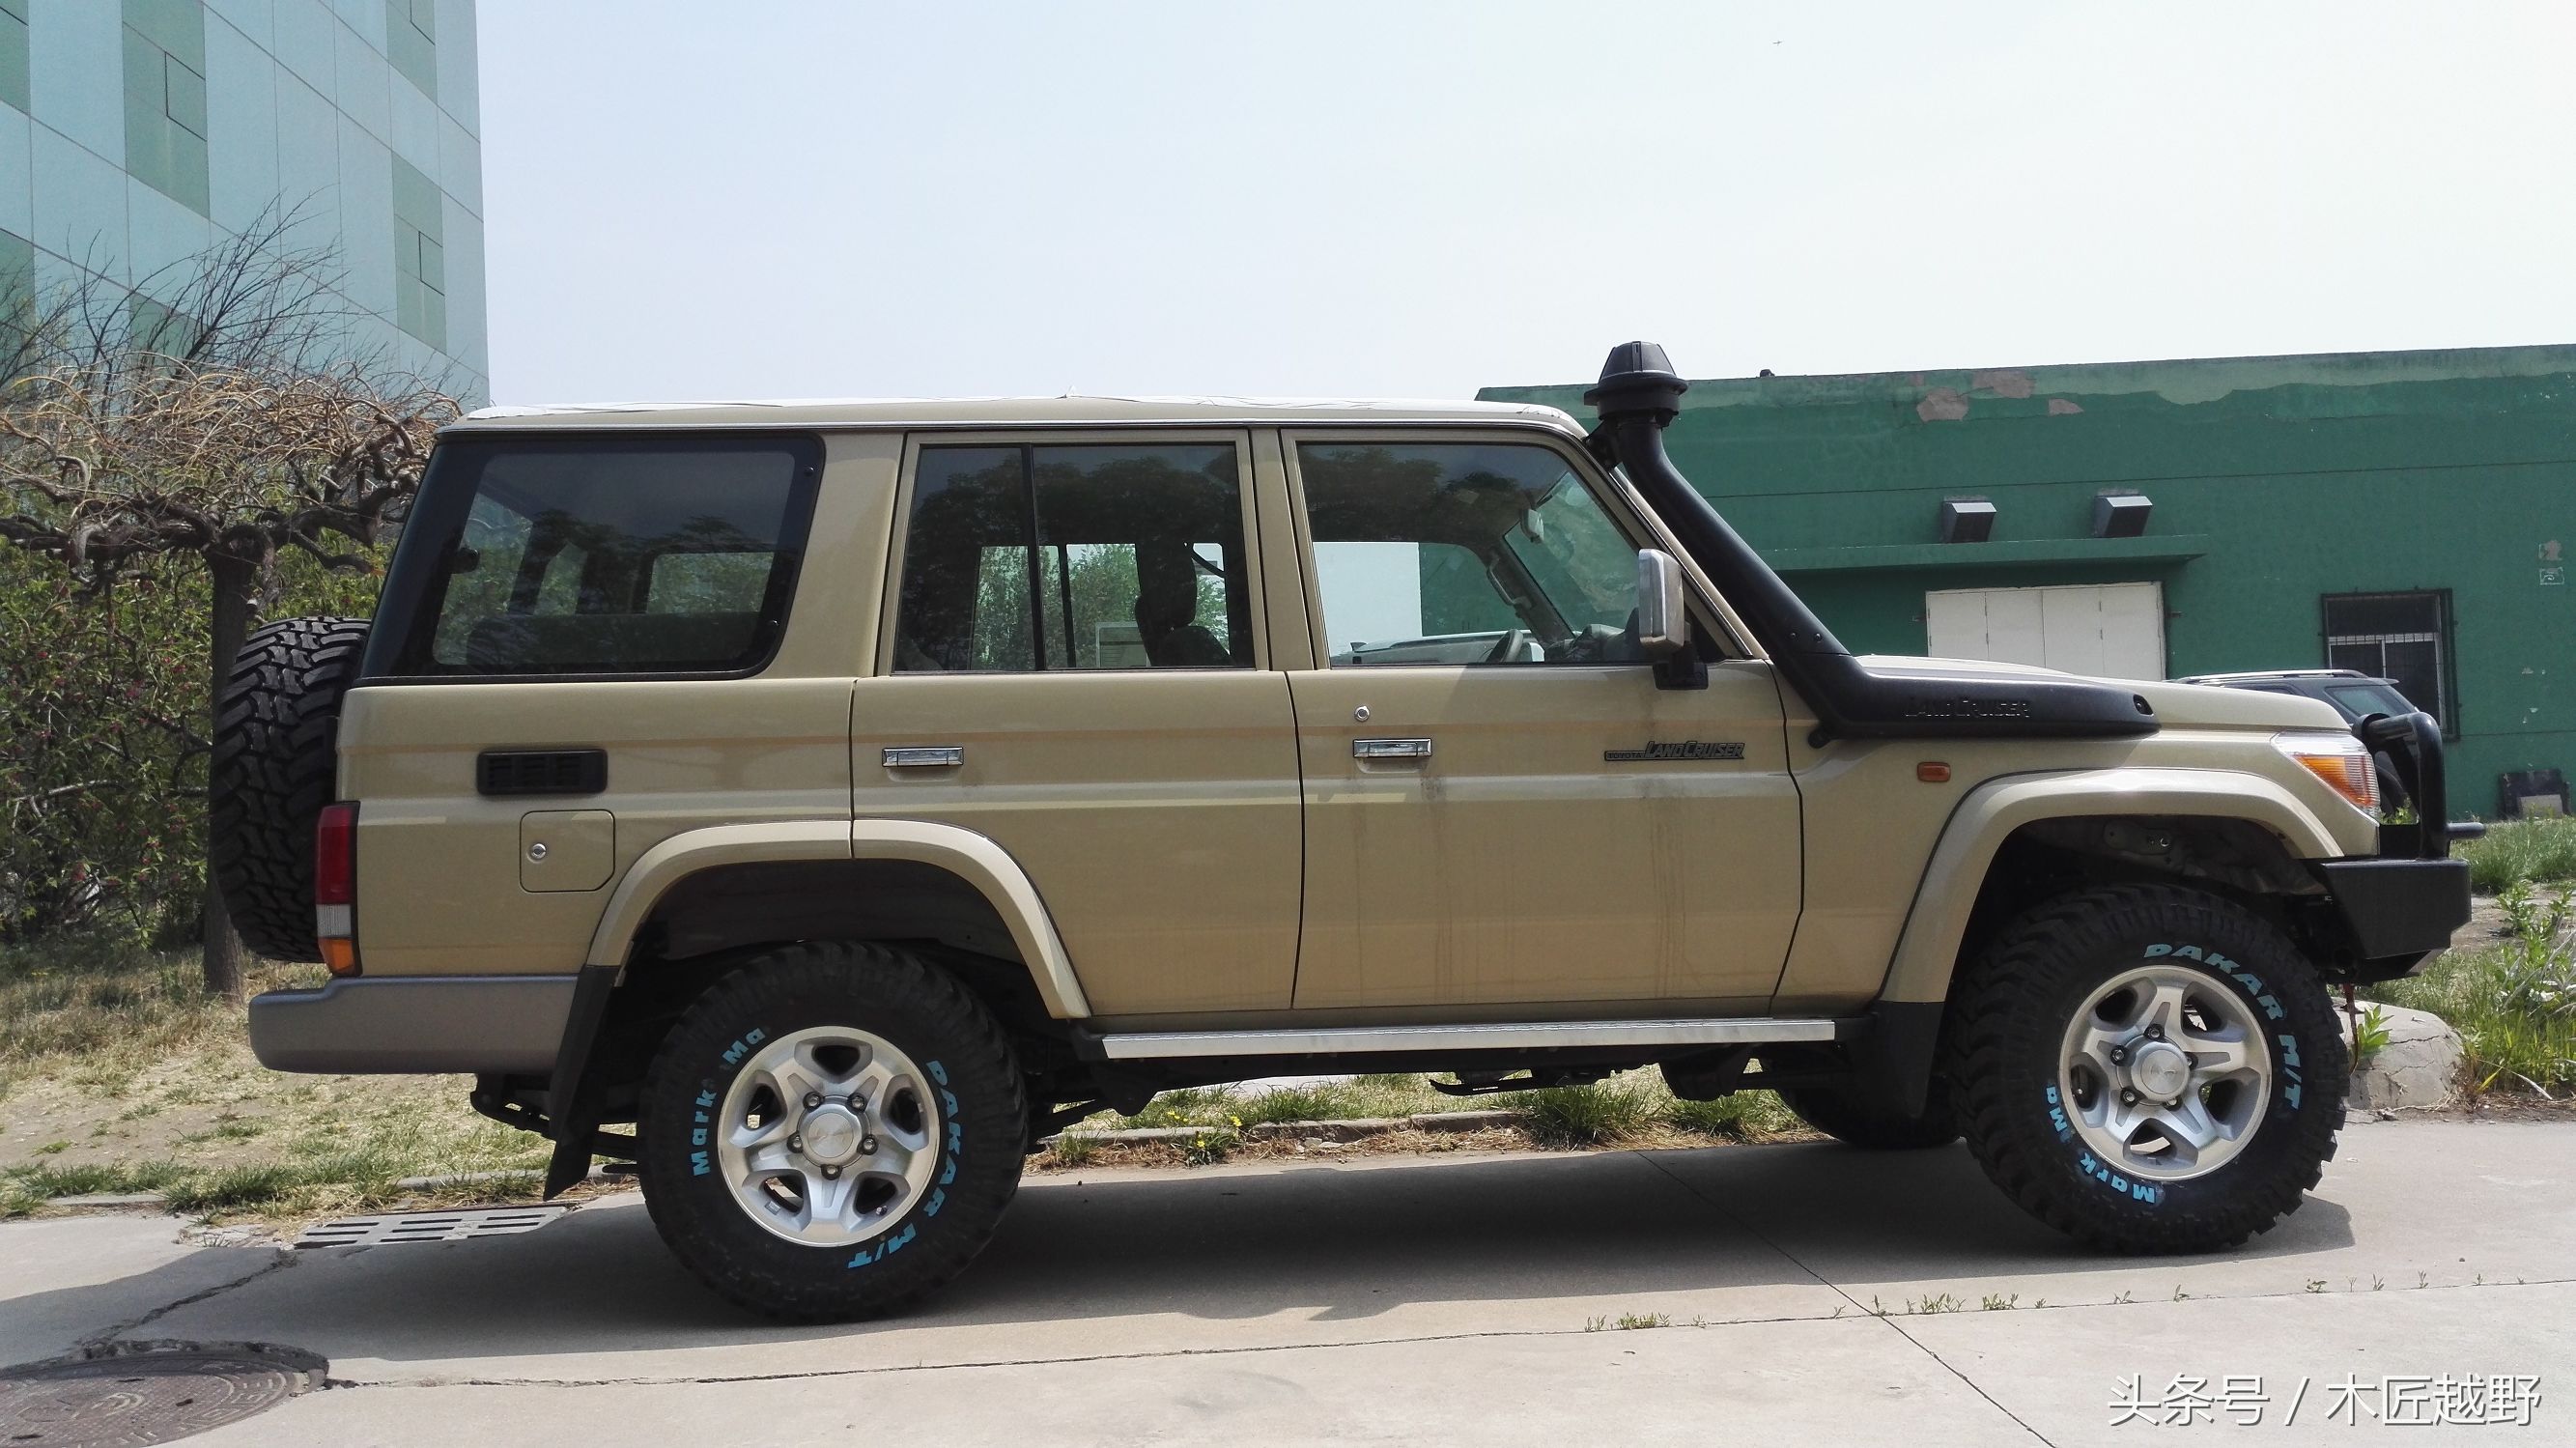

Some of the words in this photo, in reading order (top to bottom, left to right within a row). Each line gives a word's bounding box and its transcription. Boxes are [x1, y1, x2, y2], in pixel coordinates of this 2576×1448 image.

[2143, 943, 2286, 1020] DAKAR
[2278, 1035, 2303, 1110] M/T
[692, 1089, 718, 1177] Mark
[722, 1027, 767, 1065] Ma
[923, 1060, 962, 1217] DAKAR
[846, 1223, 917, 1269] M/T
[2080, 1151, 2156, 1205] Mark
